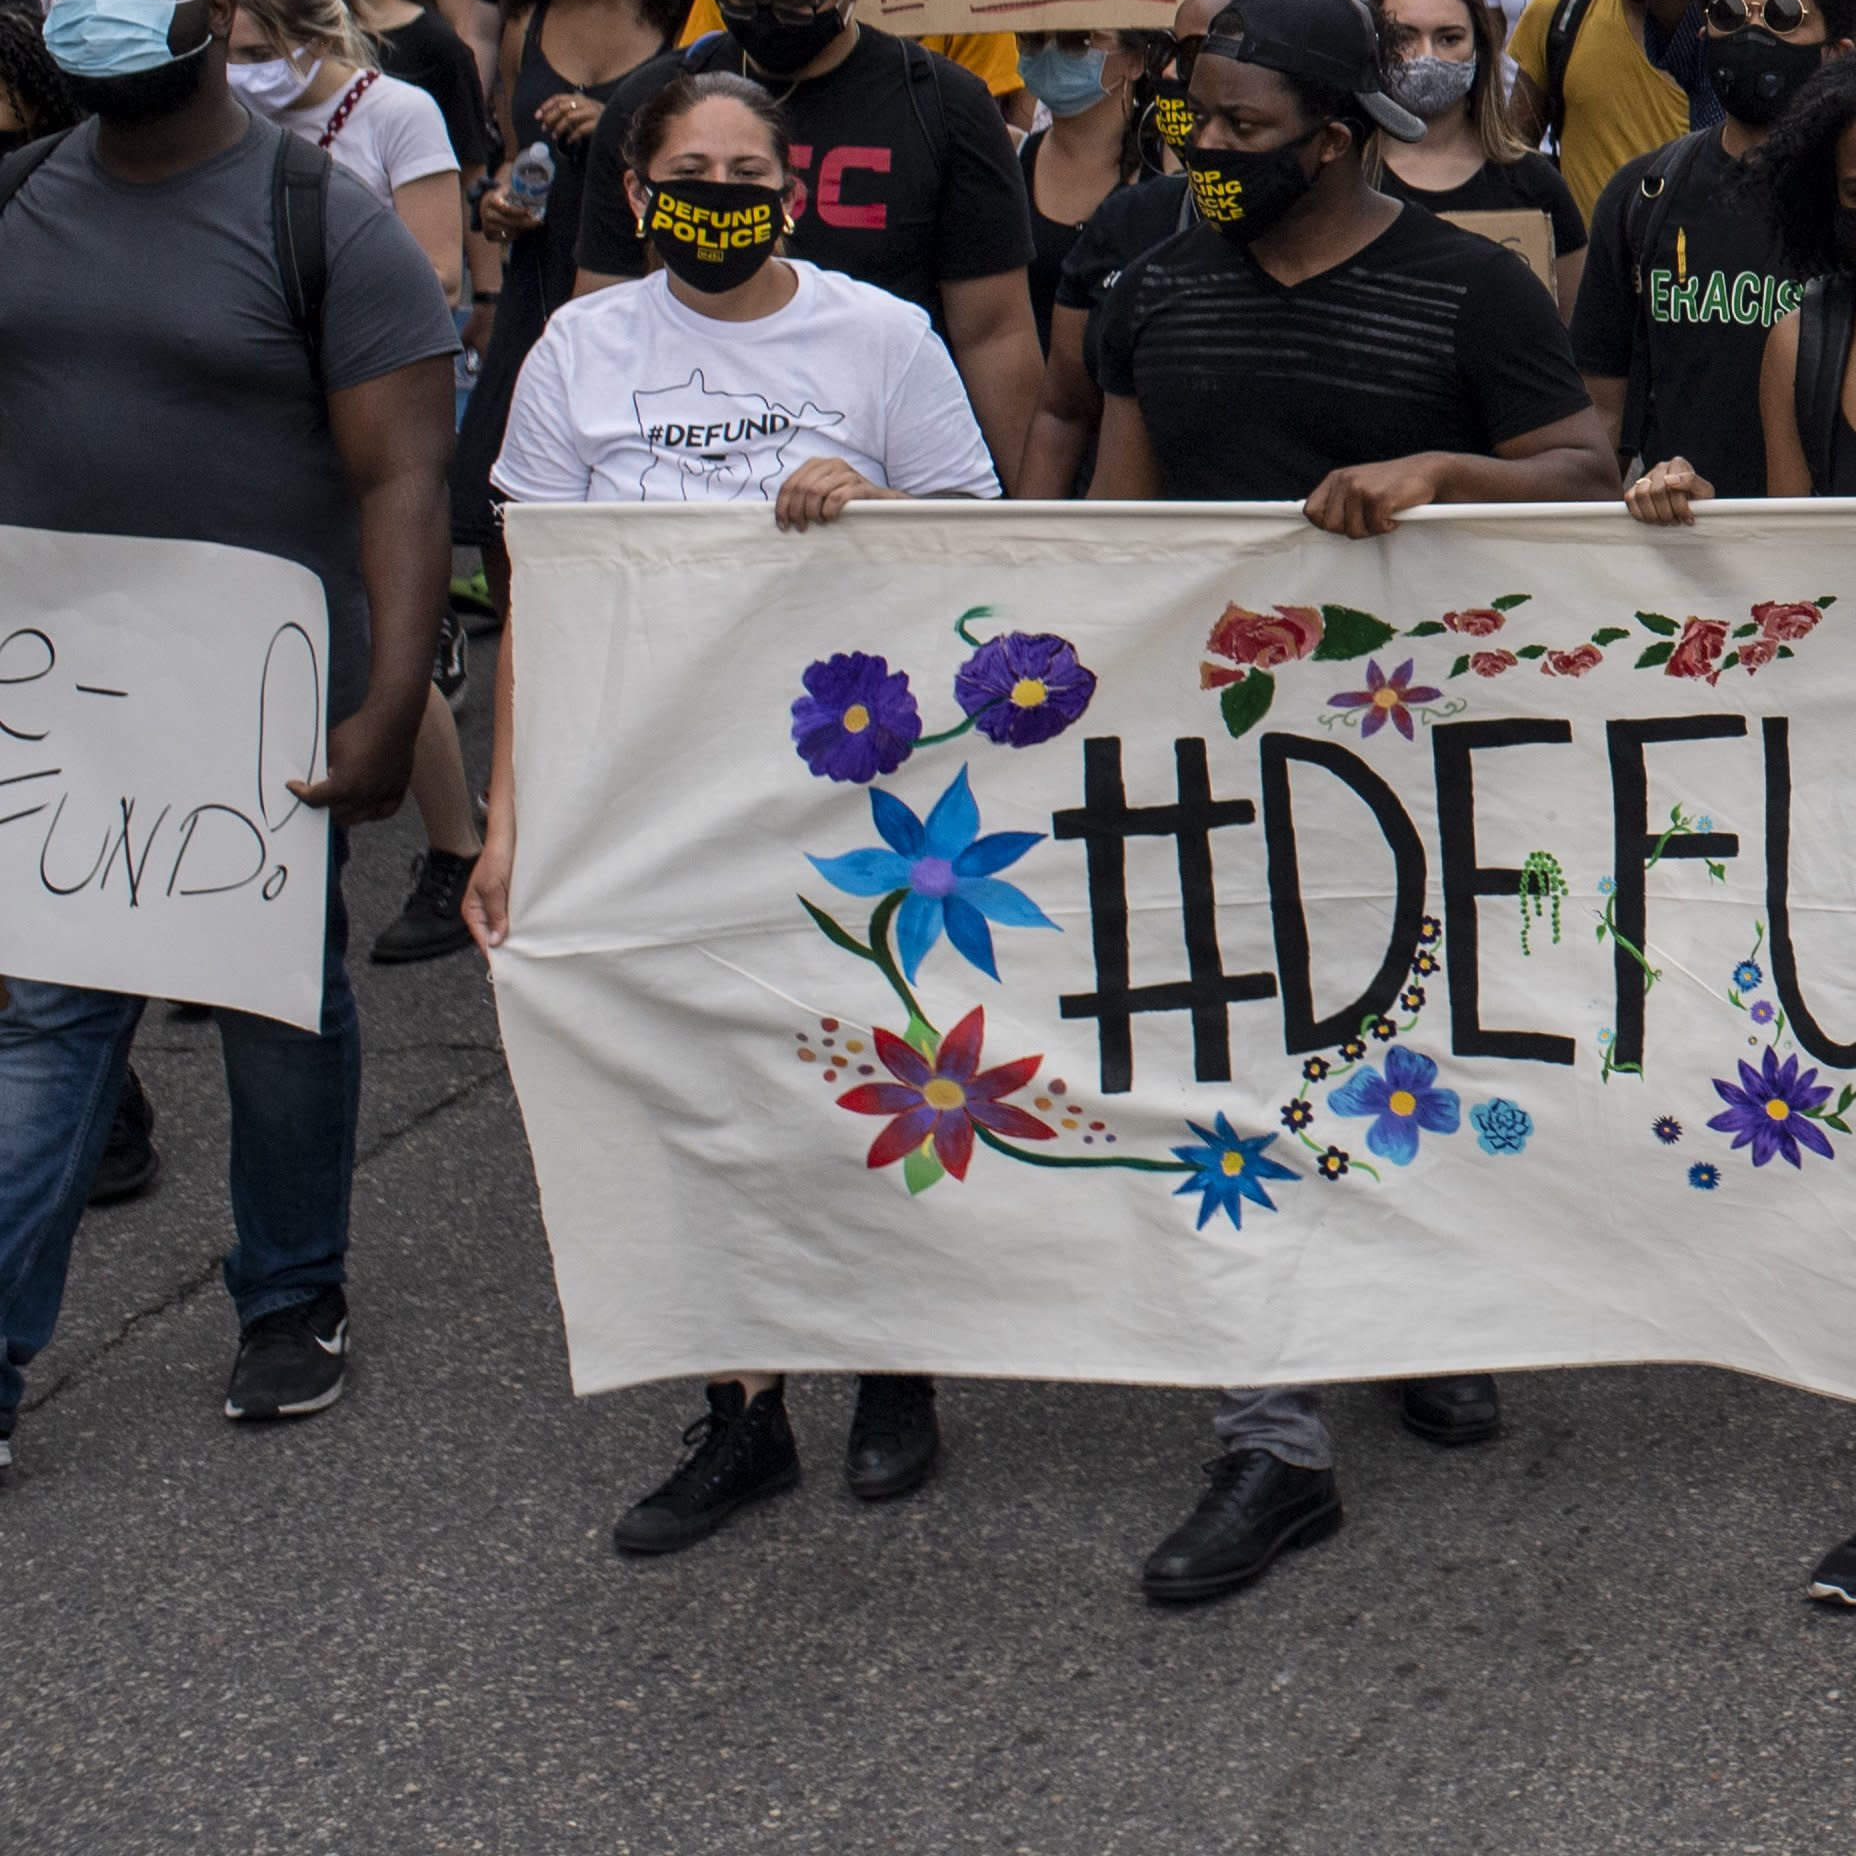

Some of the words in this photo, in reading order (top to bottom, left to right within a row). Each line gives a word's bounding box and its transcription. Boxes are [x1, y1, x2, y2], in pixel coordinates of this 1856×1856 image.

[650, 208, 773, 251] POLICE
[659, 191, 771, 230] DEFUND
[648, 413, 790, 450] #DEFUND
